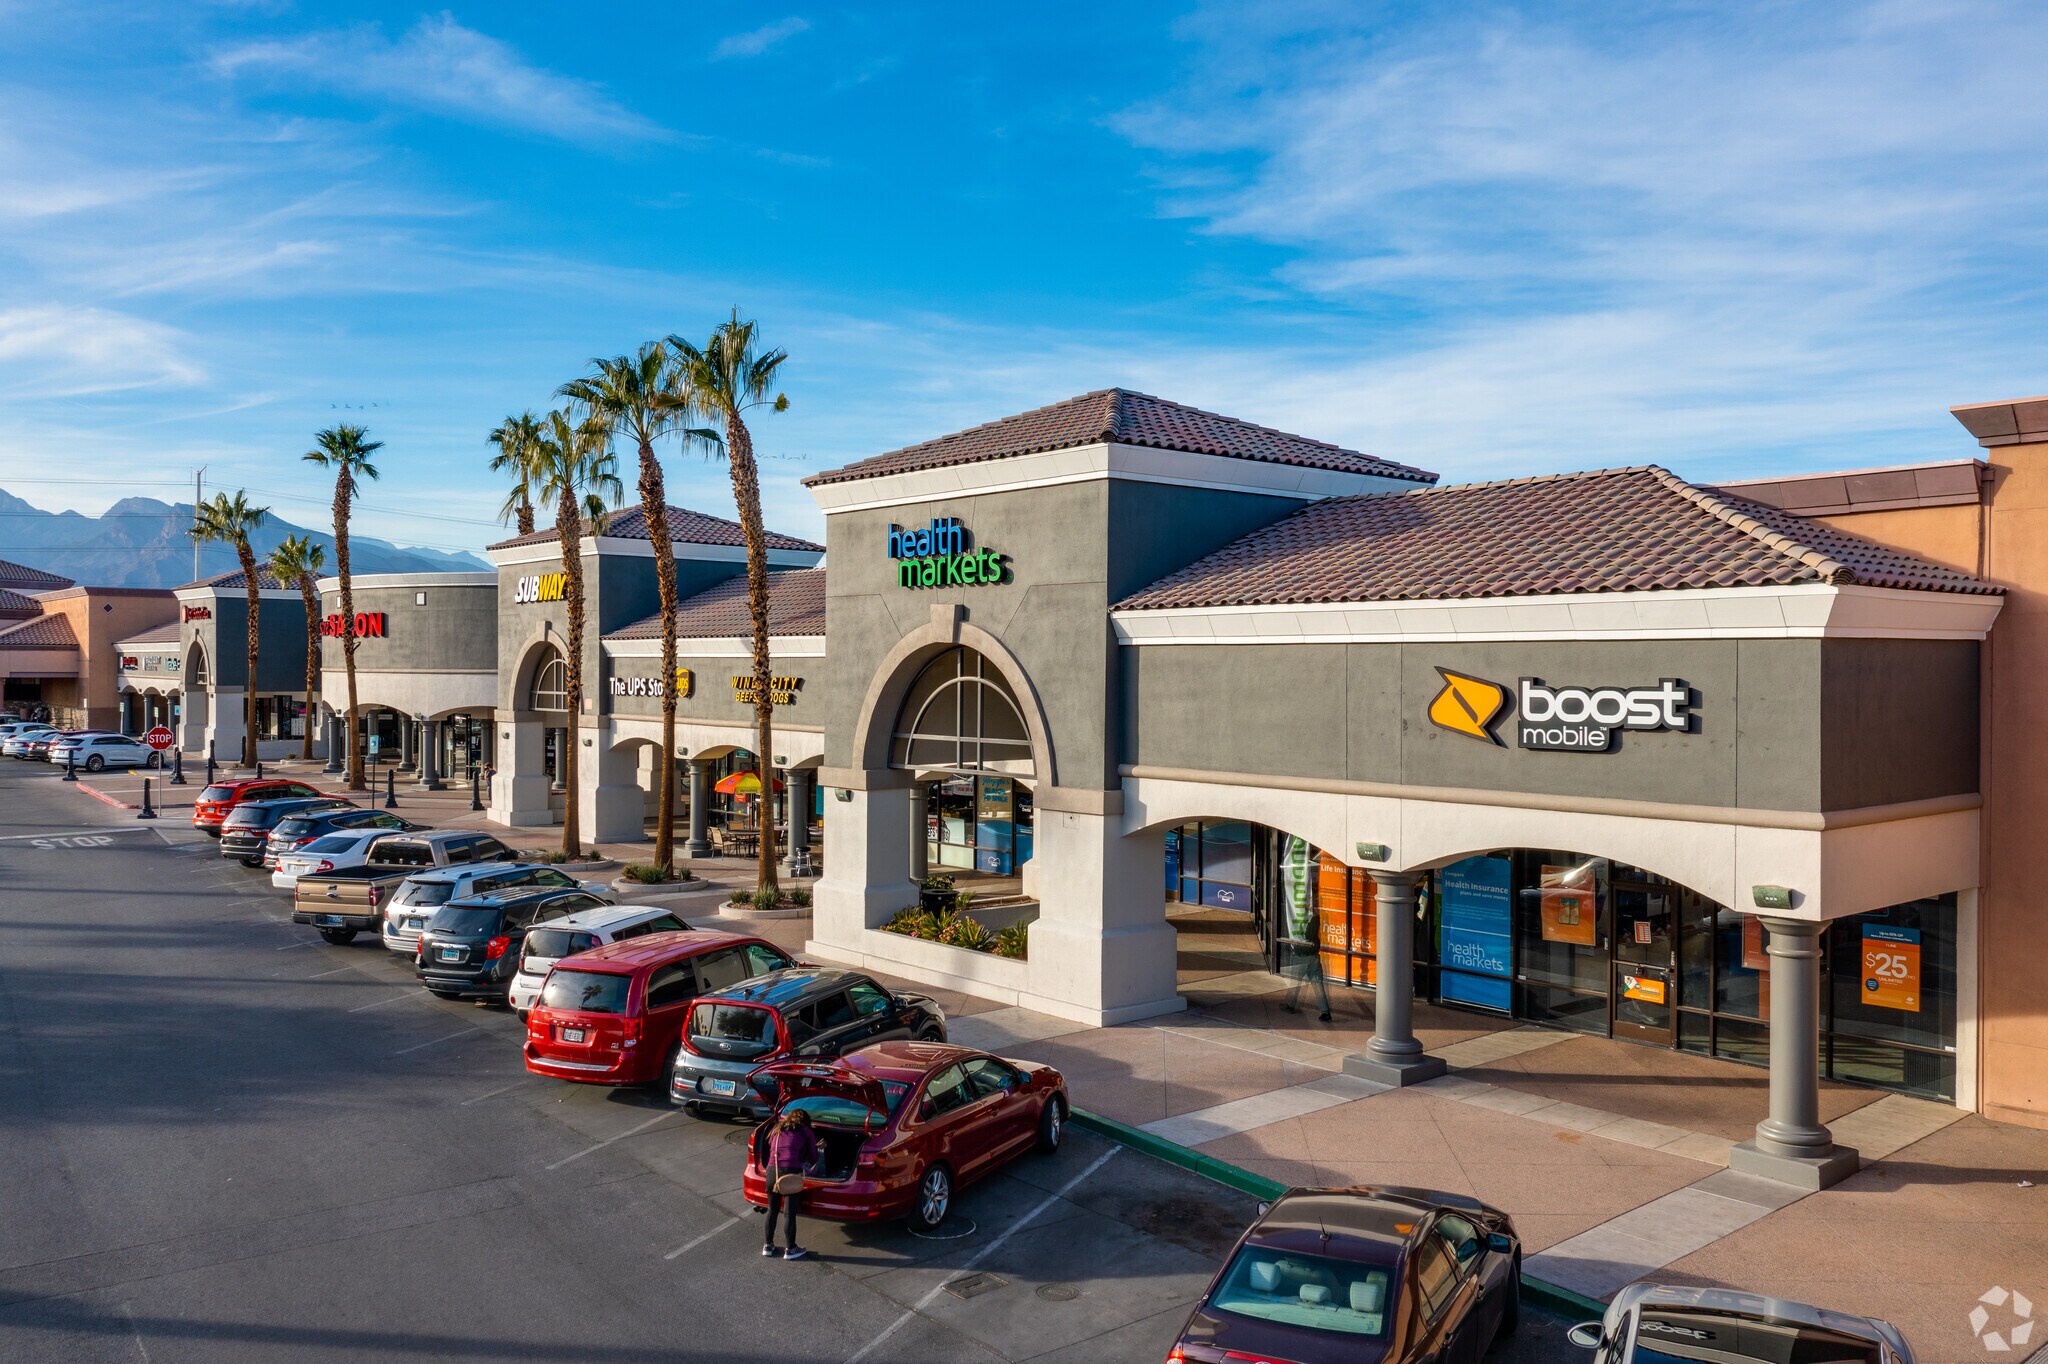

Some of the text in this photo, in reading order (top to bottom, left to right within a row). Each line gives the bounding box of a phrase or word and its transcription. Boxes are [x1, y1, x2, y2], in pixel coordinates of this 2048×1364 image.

[888, 517, 963, 558] health
[899, 547, 1001, 587] markets
[515, 573, 567, 603] SUBWAY
[329, 612, 382, 637] SAON
[610, 677, 626, 695] The
[627, 678, 645, 696] UPS
[731, 676, 797, 690] WIND CITY
[1522, 681, 1684, 726] boost
[149, 734, 172, 743] STOP
[30, 836, 115, 850] STOP
[1321, 864, 1333, 872] Life
[1445, 880, 1509, 894] Health Insurance
[1447, 940, 1485, 958] health
[1453, 954, 1504, 971] markets
[1865, 952, 1908, 978] $25
